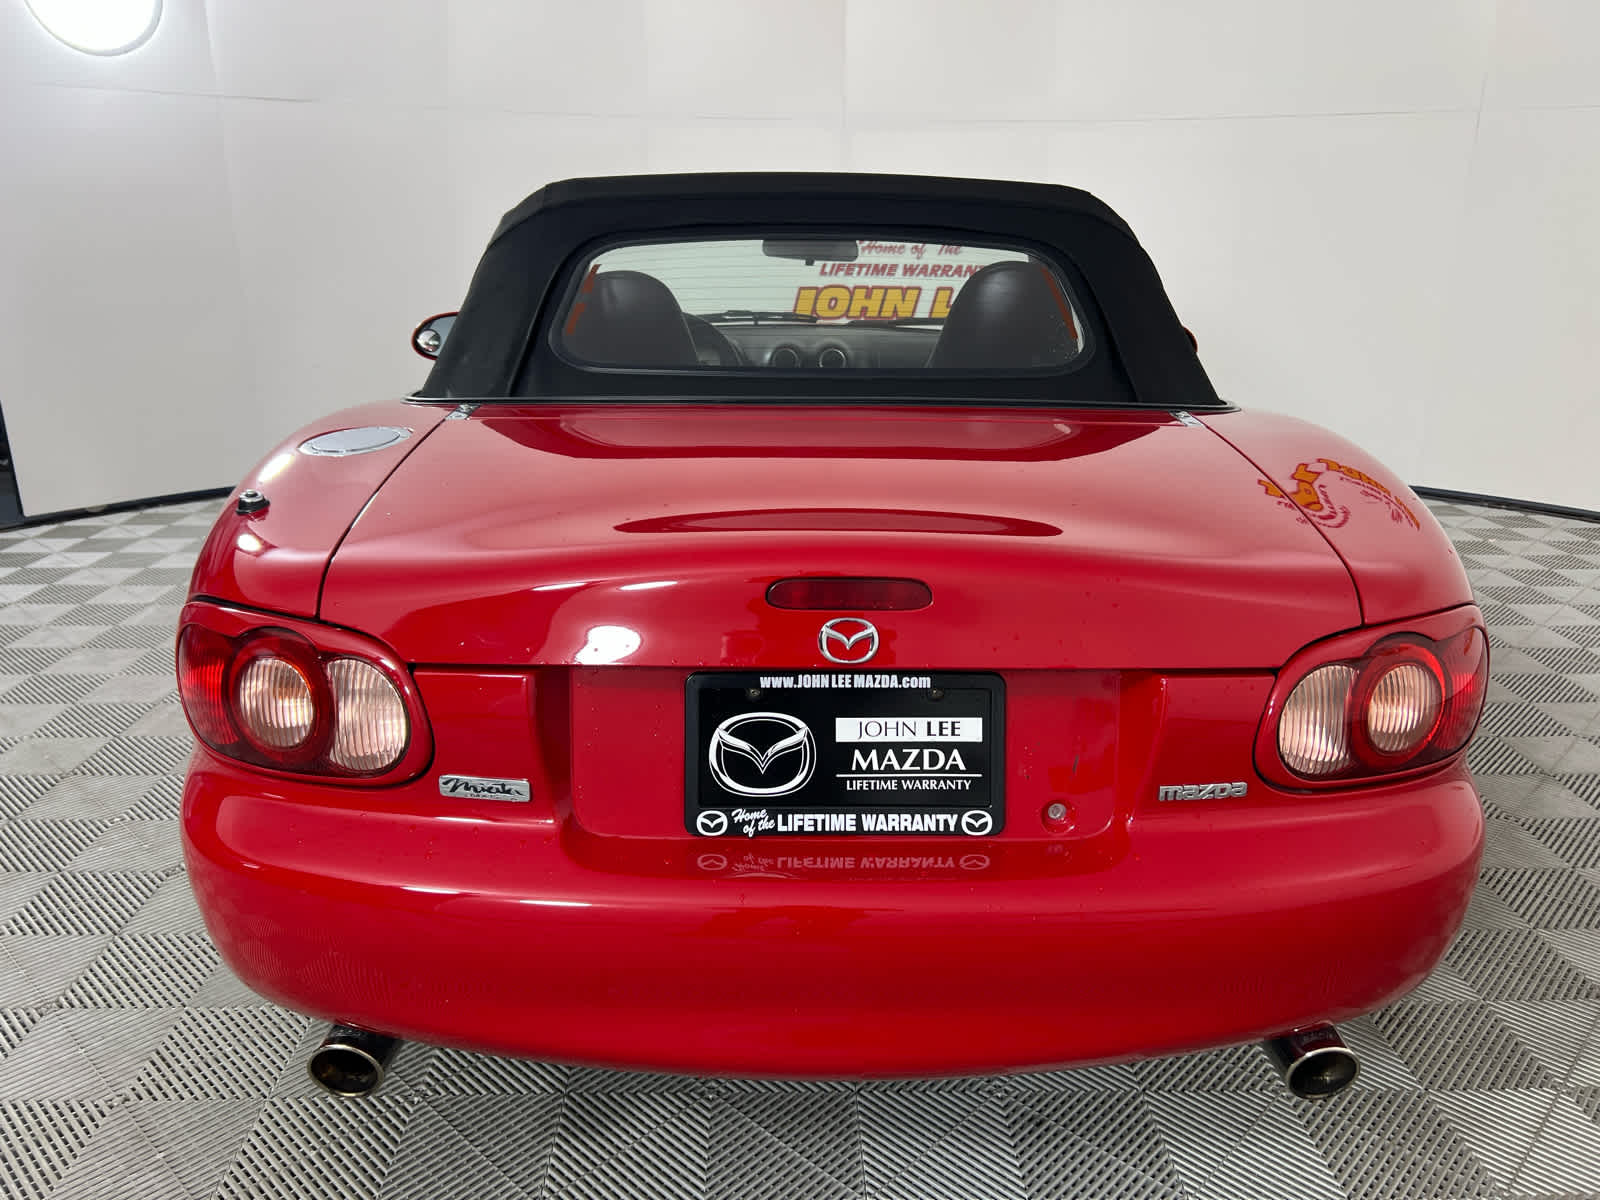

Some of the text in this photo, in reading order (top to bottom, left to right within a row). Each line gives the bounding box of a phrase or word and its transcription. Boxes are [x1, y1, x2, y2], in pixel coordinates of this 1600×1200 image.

[820, 263, 986, 278] LIFETIME WARRAN
[794, 284, 921, 320] JOHN
[831, 674, 852, 689] LEE
[857, 720, 961, 740] JOHN LEE
[851, 748, 967, 771] MAZDA
[846, 779, 972, 791] LIFETIME WARRANTY
[731, 808, 768, 823] Home
[777, 813, 958, 832] LIFETIME WARRANTY
[742, 815, 776, 838] of the
